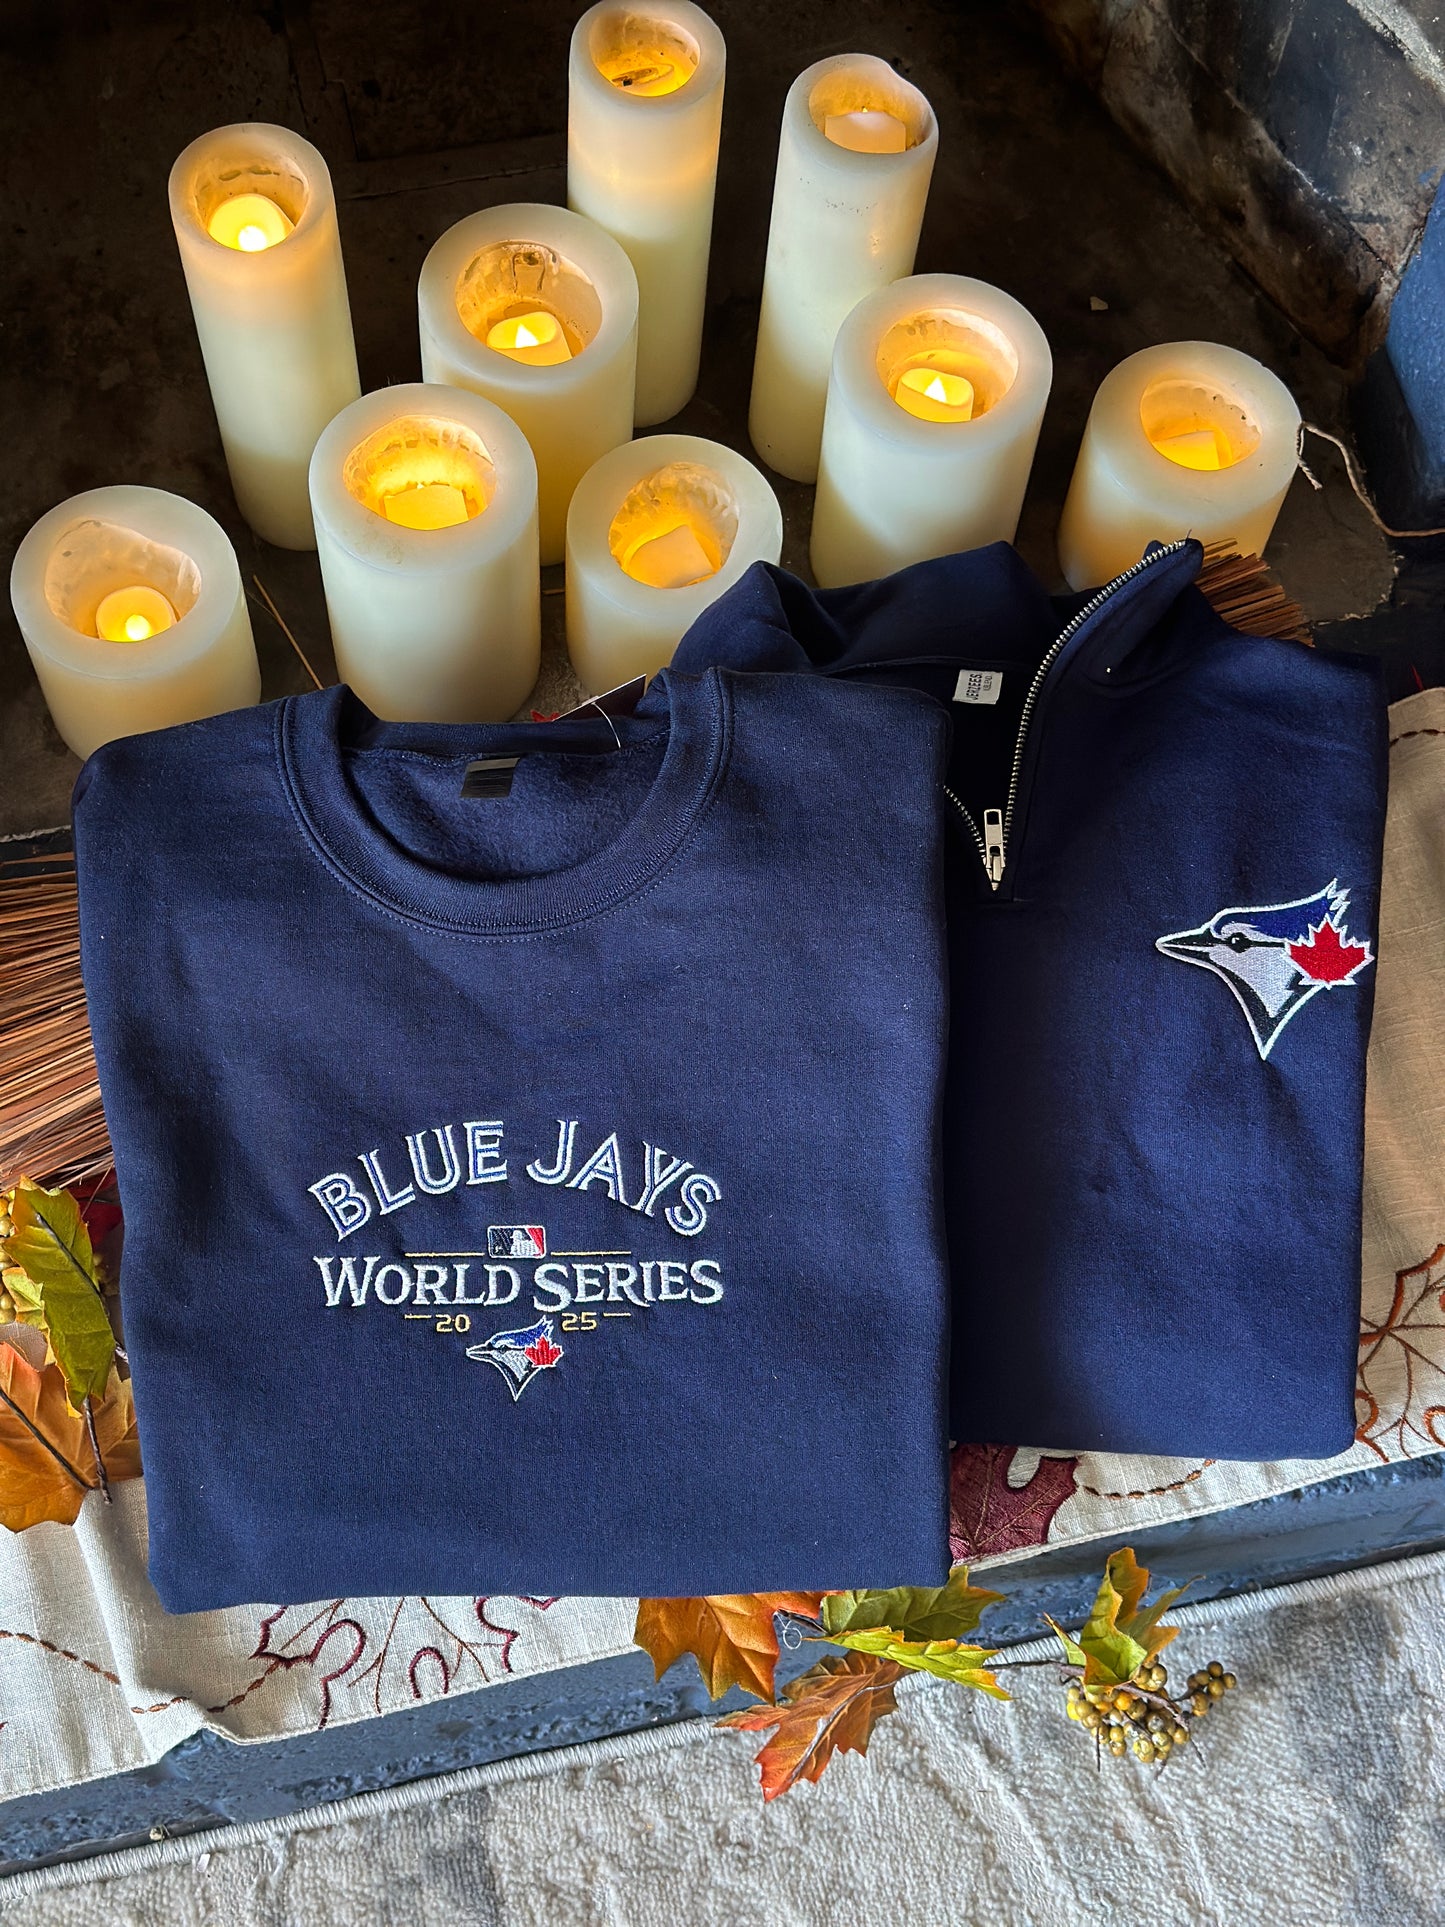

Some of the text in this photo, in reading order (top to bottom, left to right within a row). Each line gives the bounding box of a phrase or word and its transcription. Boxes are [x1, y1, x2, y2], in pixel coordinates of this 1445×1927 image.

[308, 1119, 721, 1242] BLUE JAYS
[313, 1255, 724, 1313] WORLD SERIES
[435, 1312, 597, 1333] 20 25
